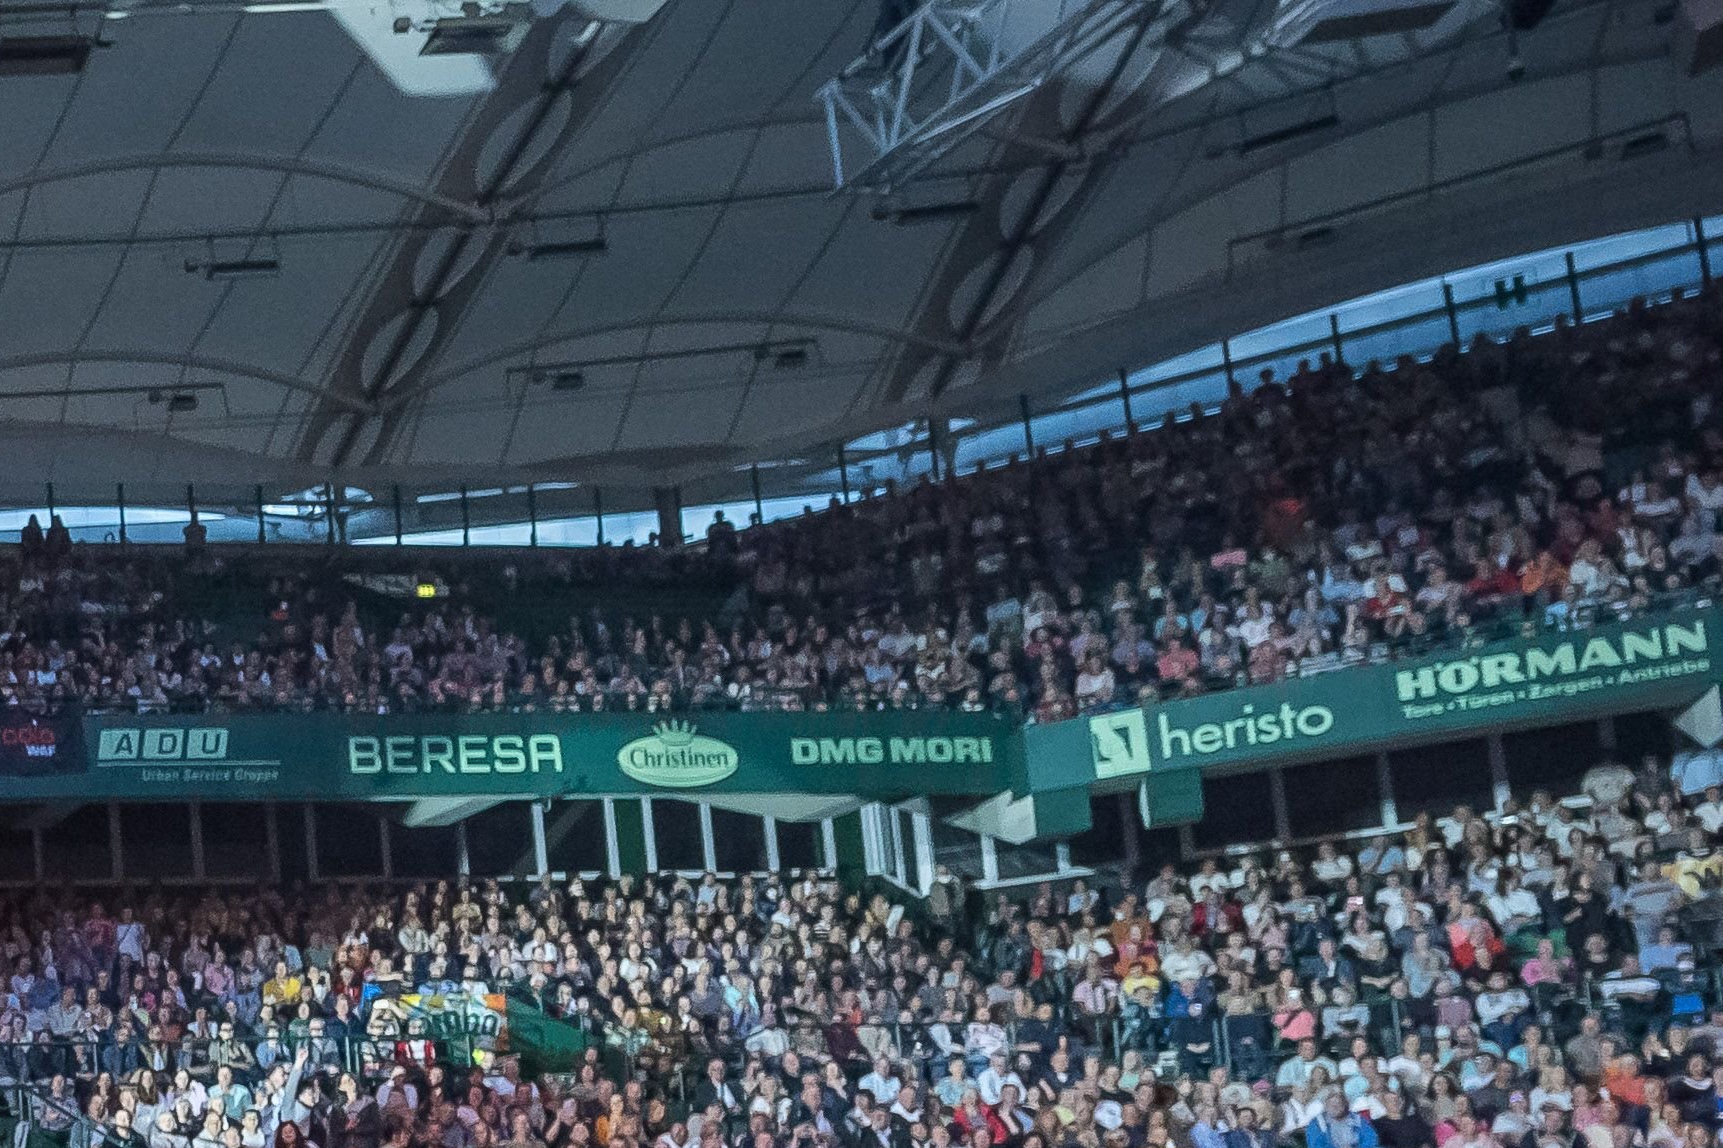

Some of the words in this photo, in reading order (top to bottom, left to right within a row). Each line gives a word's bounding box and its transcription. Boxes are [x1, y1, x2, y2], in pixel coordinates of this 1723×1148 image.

[1494, 272, 1527, 311] H
[1396, 619, 1708, 701] HÖRMANN
[111, 731, 223, 756] ADU
[791, 736, 885, 765] DMG
[889, 736, 994, 764] MORI
[1158, 702, 1334, 760] heristo
[349, 733, 564, 774] BERESA
[629, 746, 729, 769] Christinen
